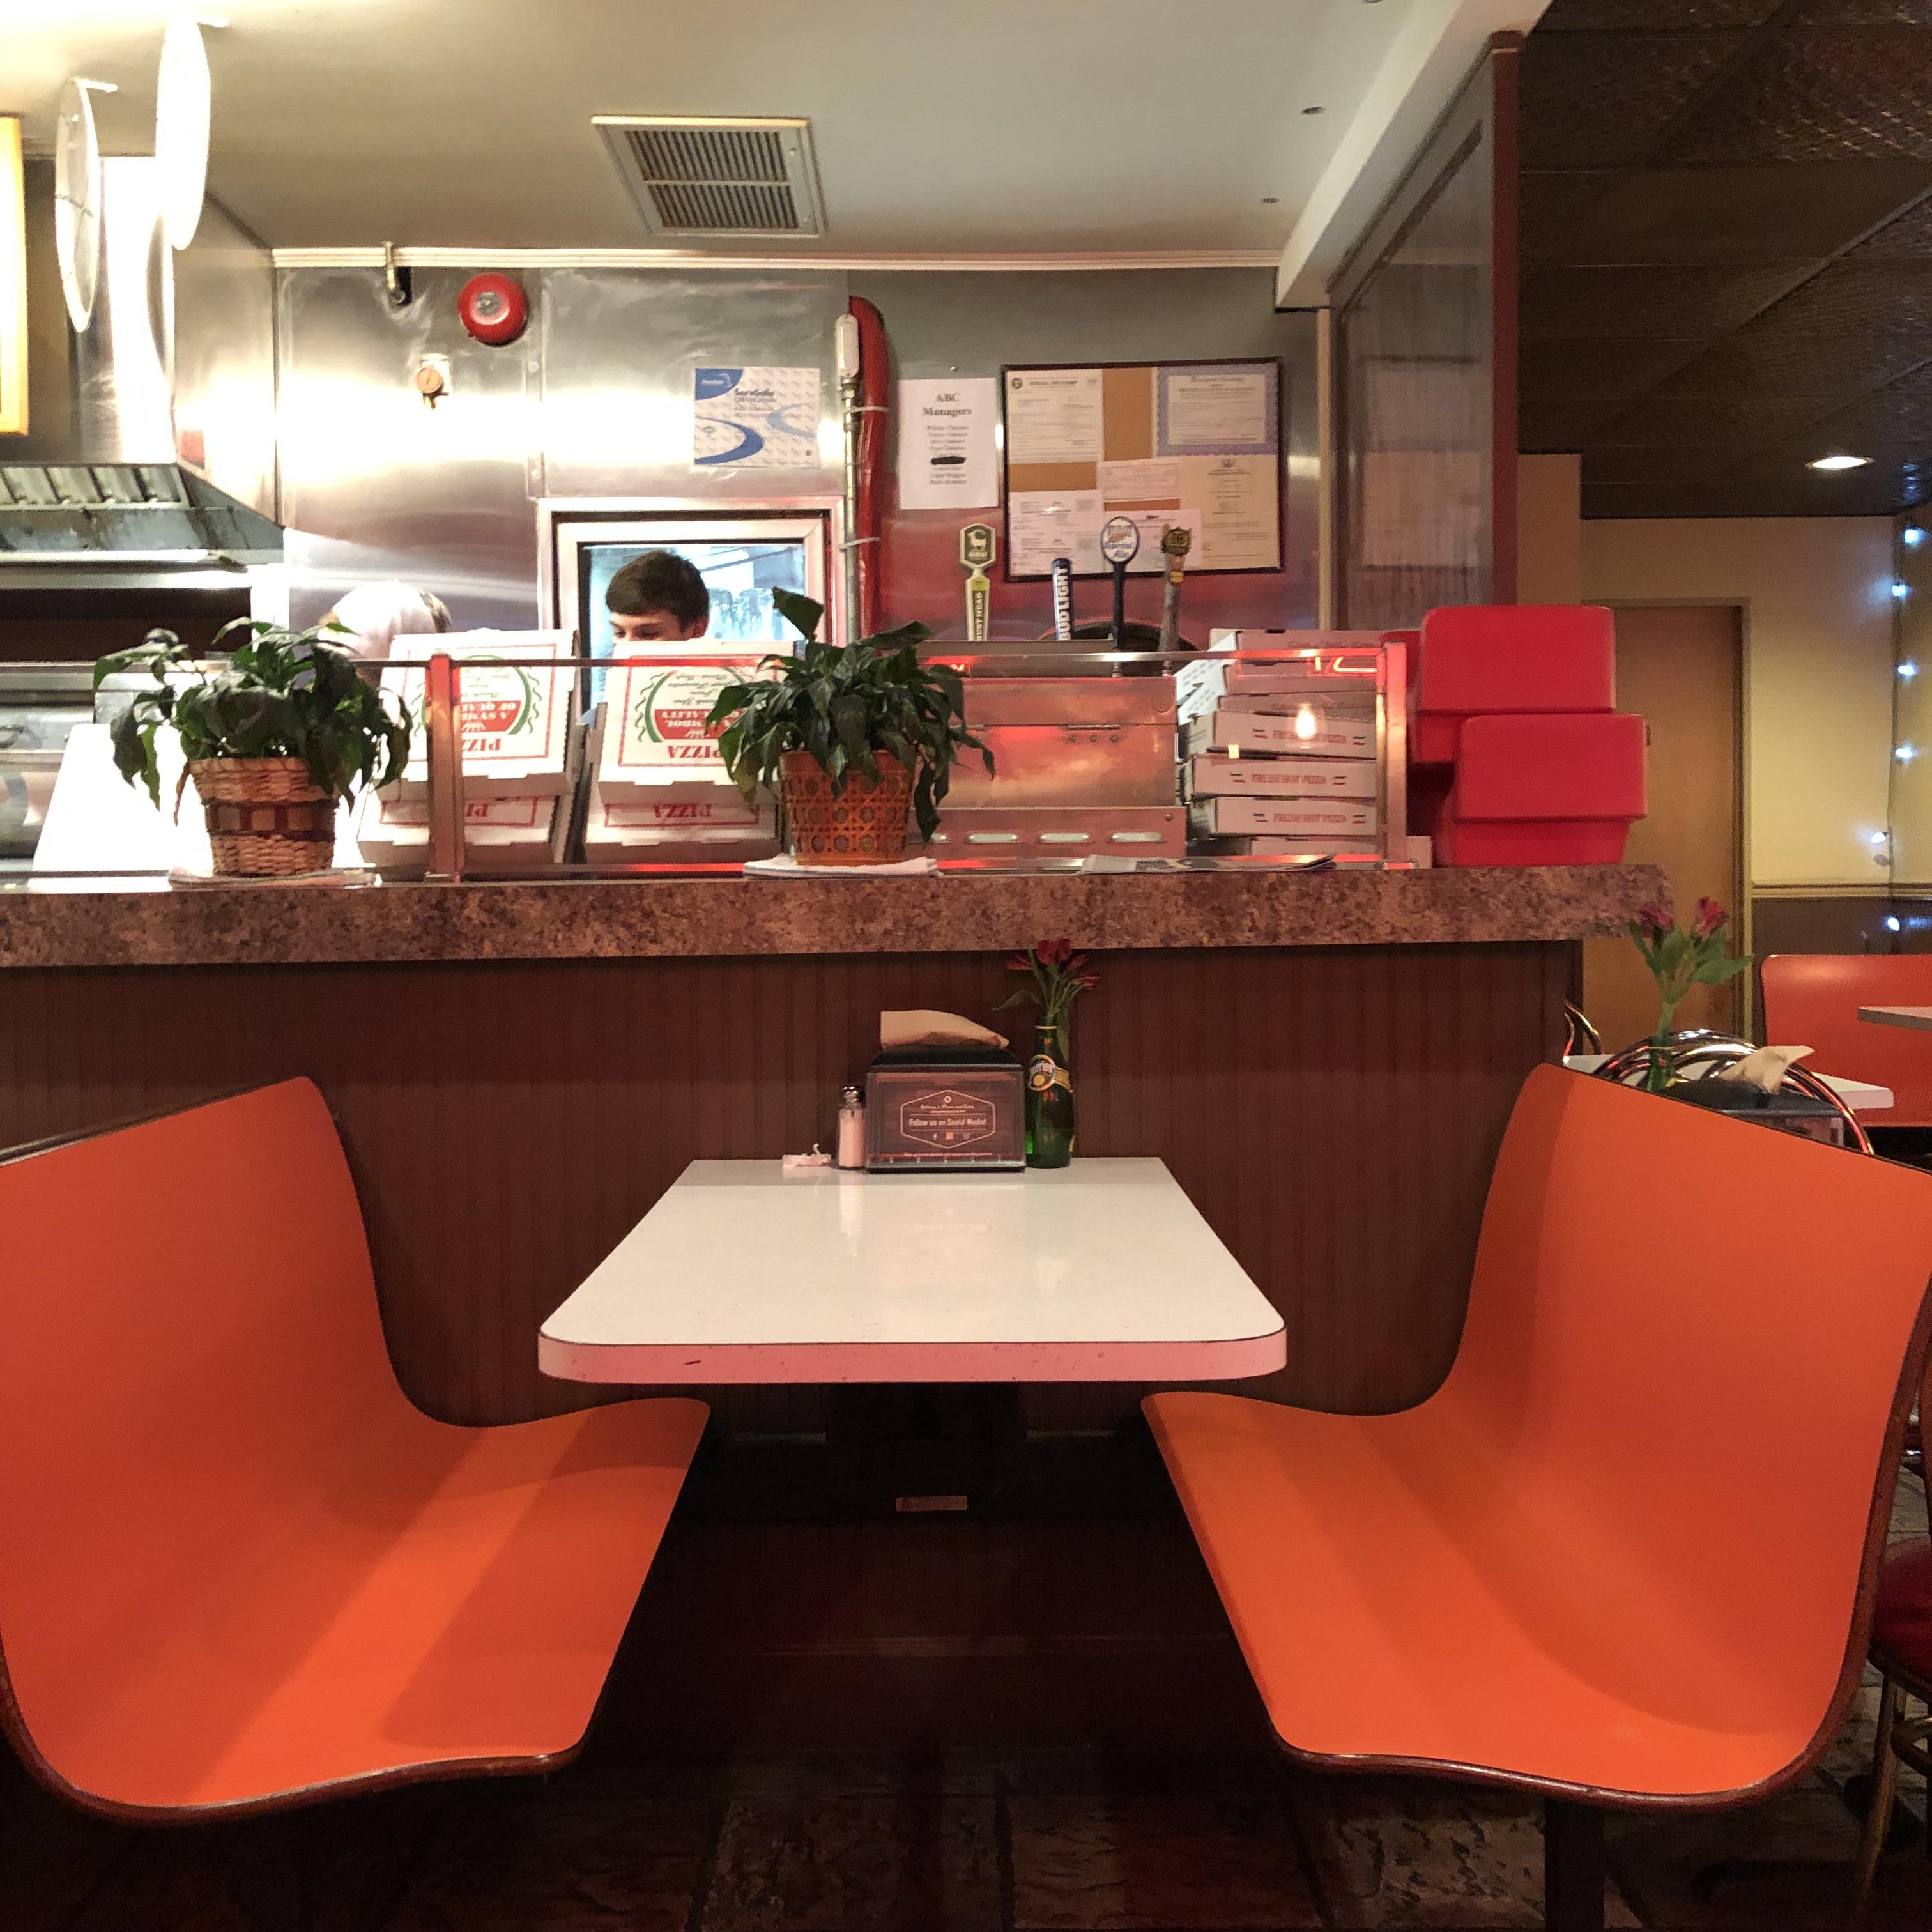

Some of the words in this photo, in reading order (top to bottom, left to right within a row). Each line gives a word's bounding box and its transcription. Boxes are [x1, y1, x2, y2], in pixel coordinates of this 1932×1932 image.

[935, 393, 960, 402] ABC
[923, 407, 973, 418] Managers
[1056, 567, 1070, 610] LIGHT
[461, 739, 502, 752] PIZ
[668, 746, 723, 758] PIZZA
[1301, 775, 1327, 785] PIZZA
[654, 803, 712, 818] PIZZA
[1322, 814, 1347, 824] PIZZA
